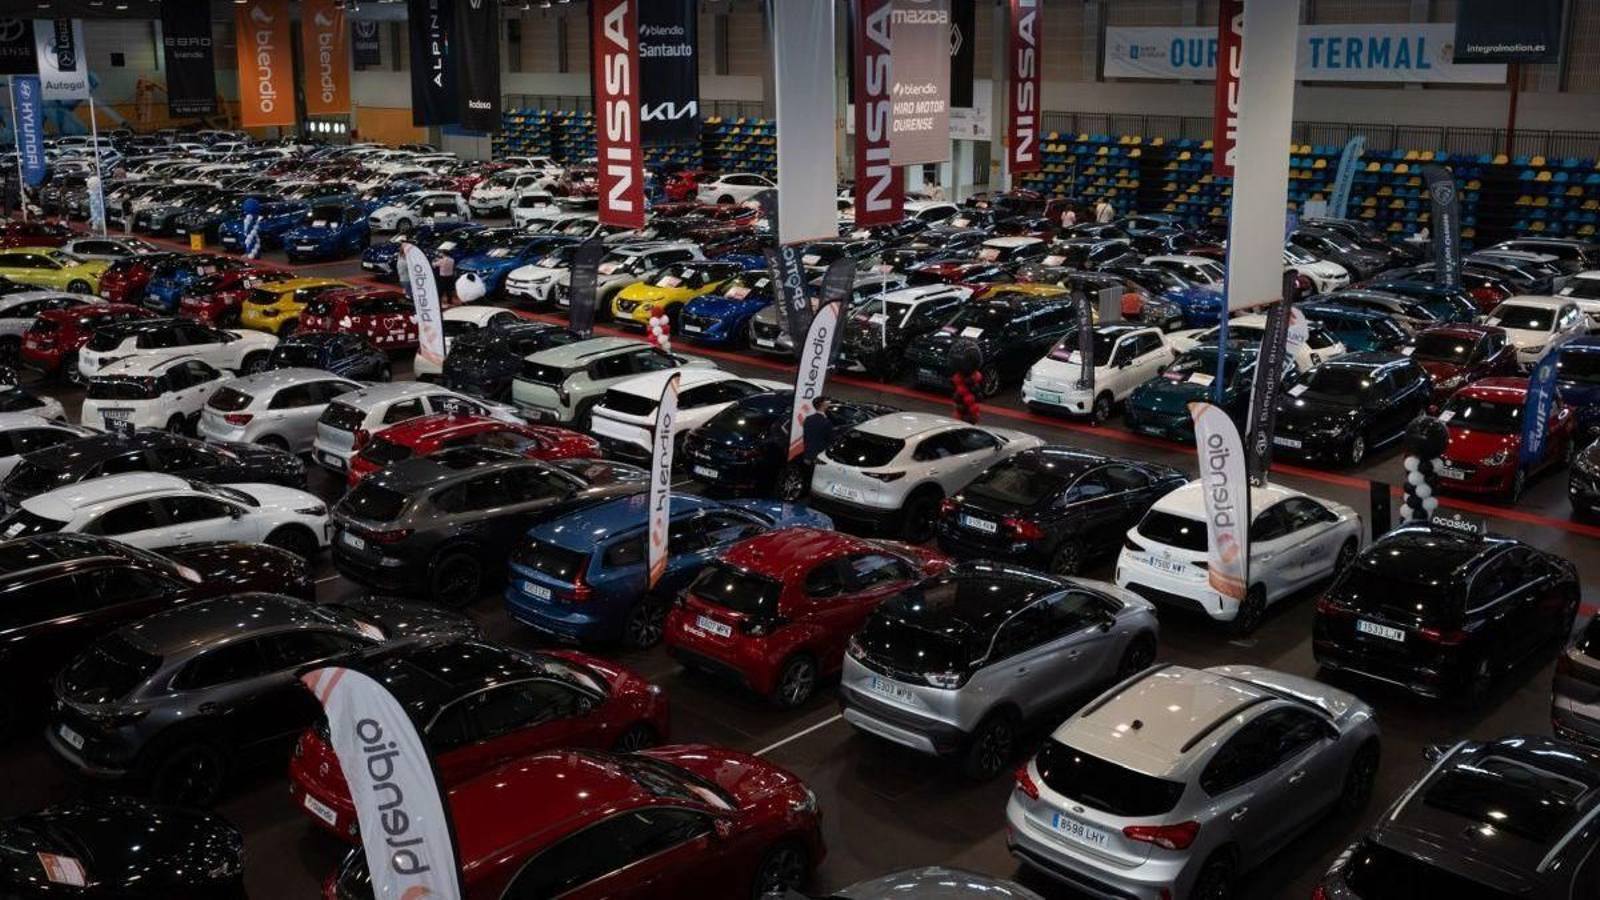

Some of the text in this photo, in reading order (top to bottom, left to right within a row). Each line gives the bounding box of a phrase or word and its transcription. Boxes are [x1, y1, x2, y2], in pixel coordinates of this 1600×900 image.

[891, 9, 948, 24] mazda
[650, 25, 684, 35] blendio
[164, 37, 211, 46] EBRO
[430, 0, 442, 87] ALPINE
[639, 42, 692, 57] Santauto
[1467, 43, 1546, 53] integralmotion.es
[1309, 36, 1431, 70] TERMAL
[256, 32, 277, 113] blendio
[319, 33, 336, 104] blendio
[904, 83, 938, 95] blendio
[641, 101, 697, 121] KIA
[893, 101, 945, 115] HIRO MOTOR
[893, 118, 934, 131] OURENSE
[22, 102, 38, 170] HYUNDAI
[801, 327, 827, 401] blendio
[1060, 817, 1106, 844] 8598 LHY
